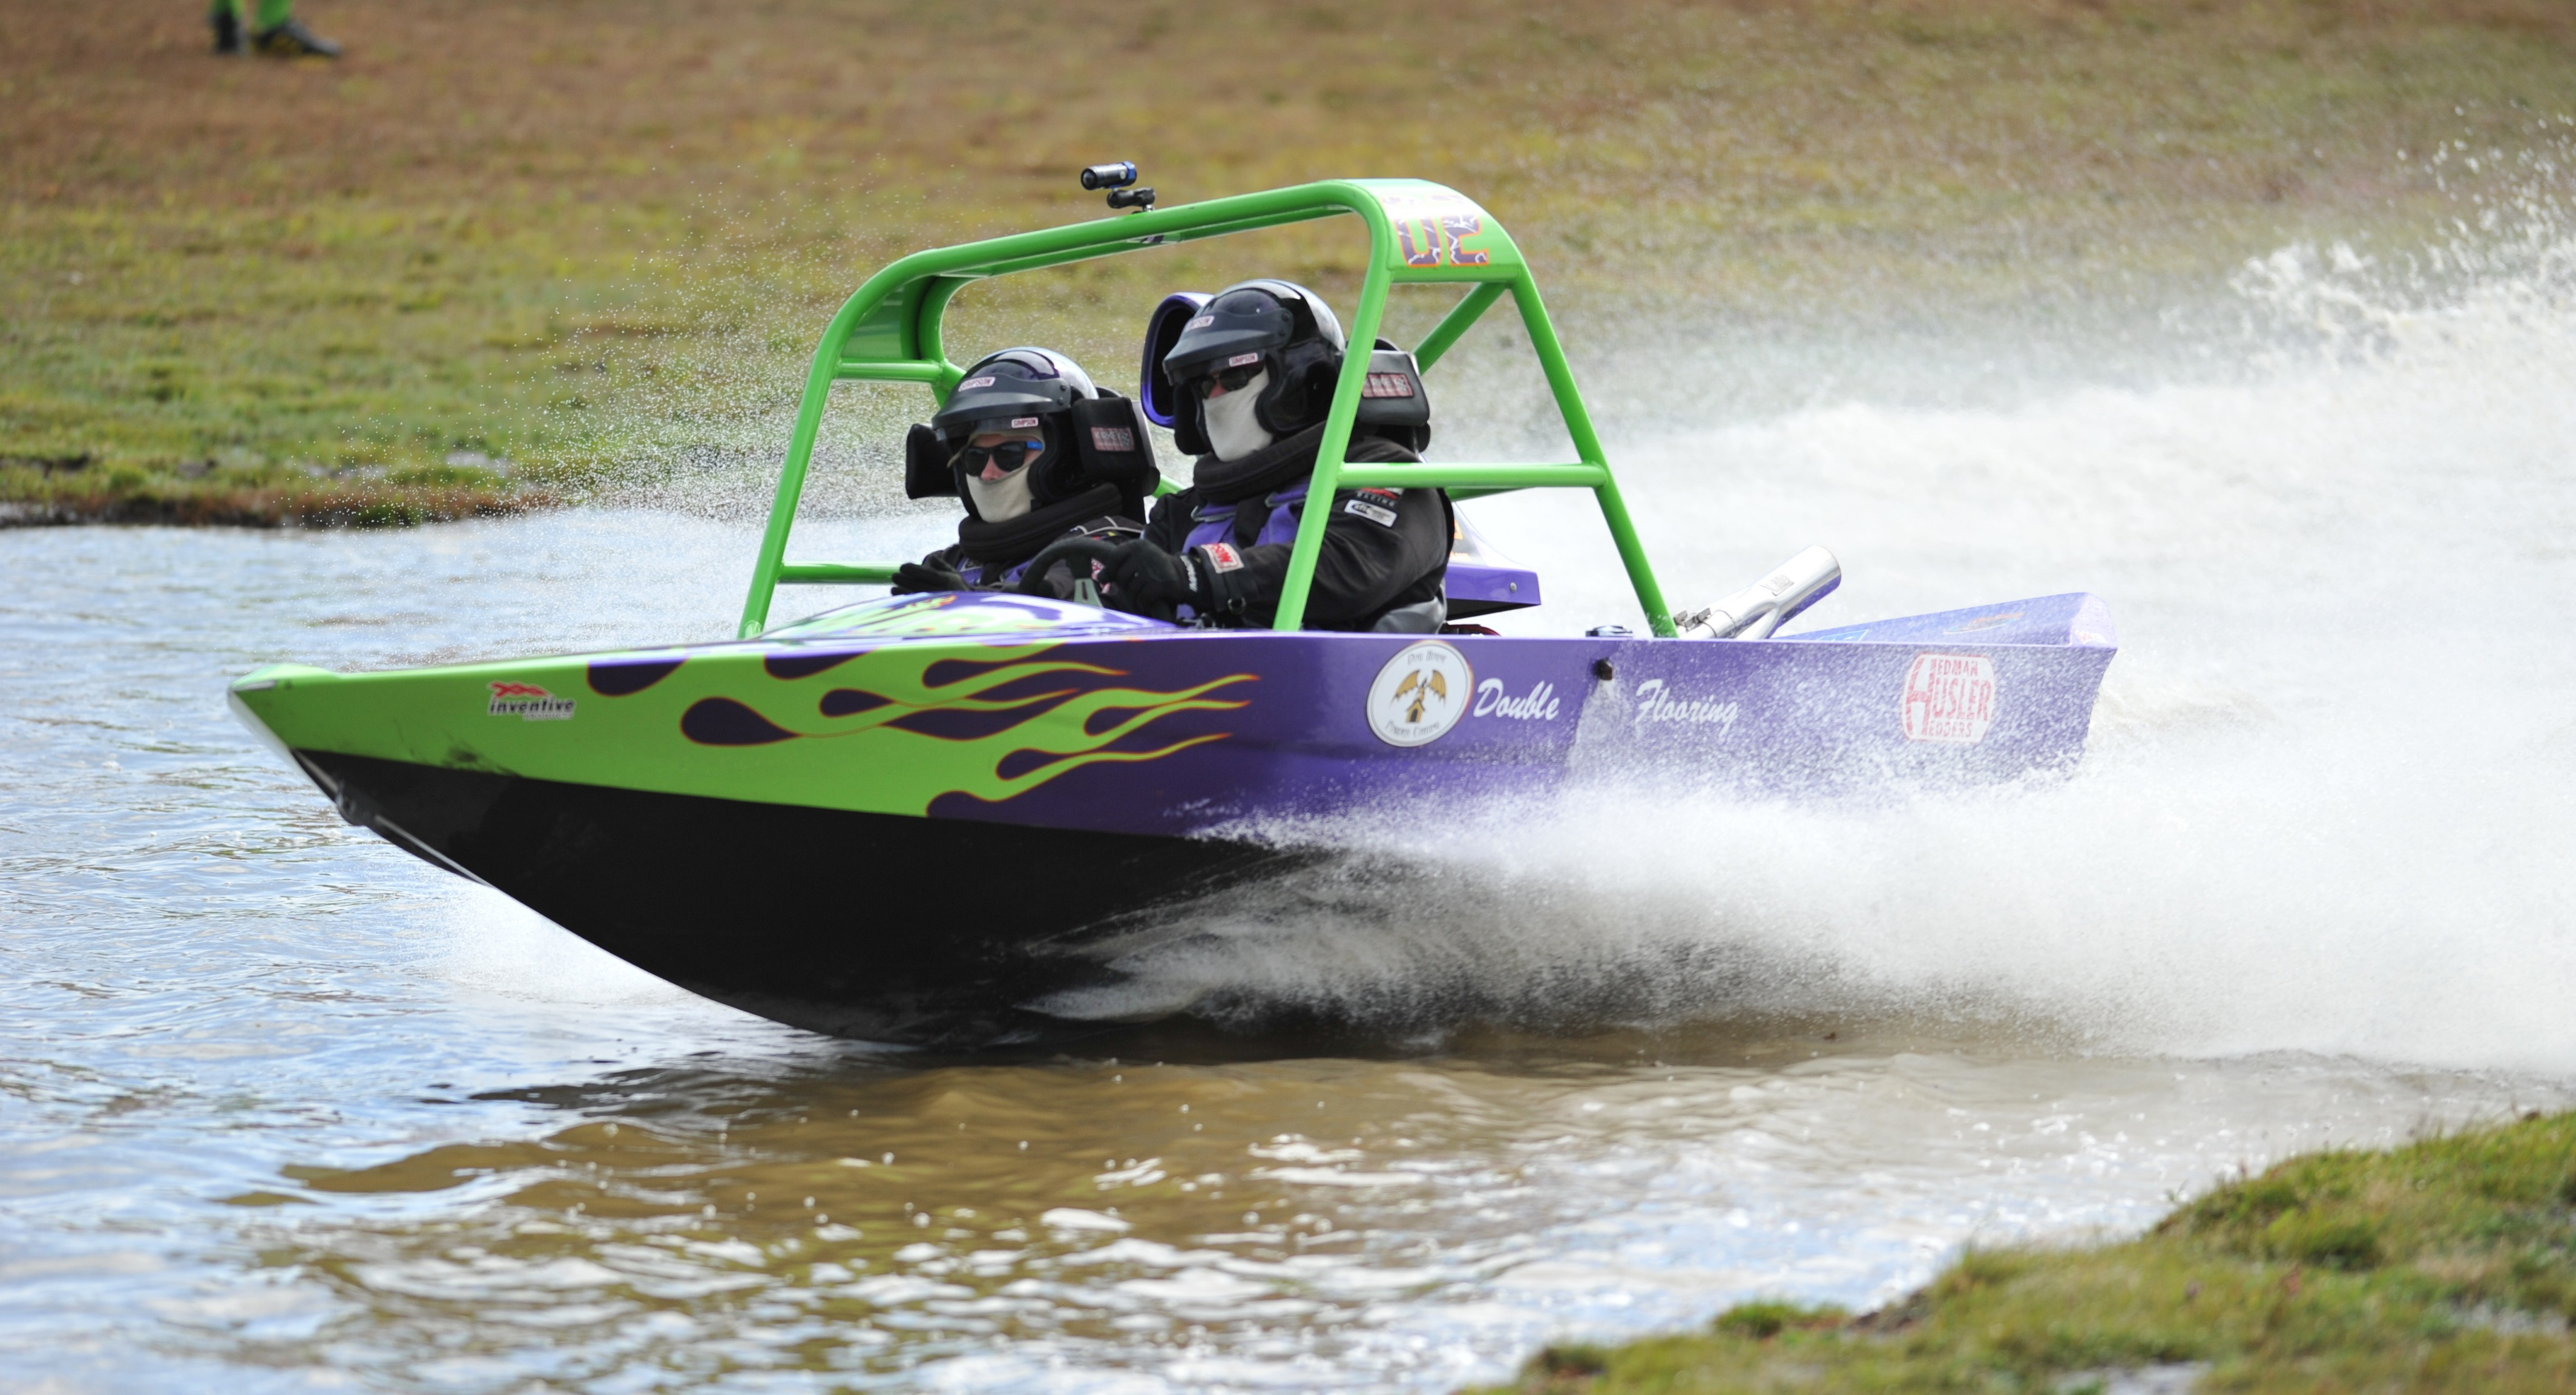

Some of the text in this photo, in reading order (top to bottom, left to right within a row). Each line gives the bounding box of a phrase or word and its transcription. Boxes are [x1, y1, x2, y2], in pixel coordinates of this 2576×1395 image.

[961, 378, 991, 389] SIMPSON
[490, 696, 574, 713] inventive
[1473, 678, 1739, 735] Double Flooring
